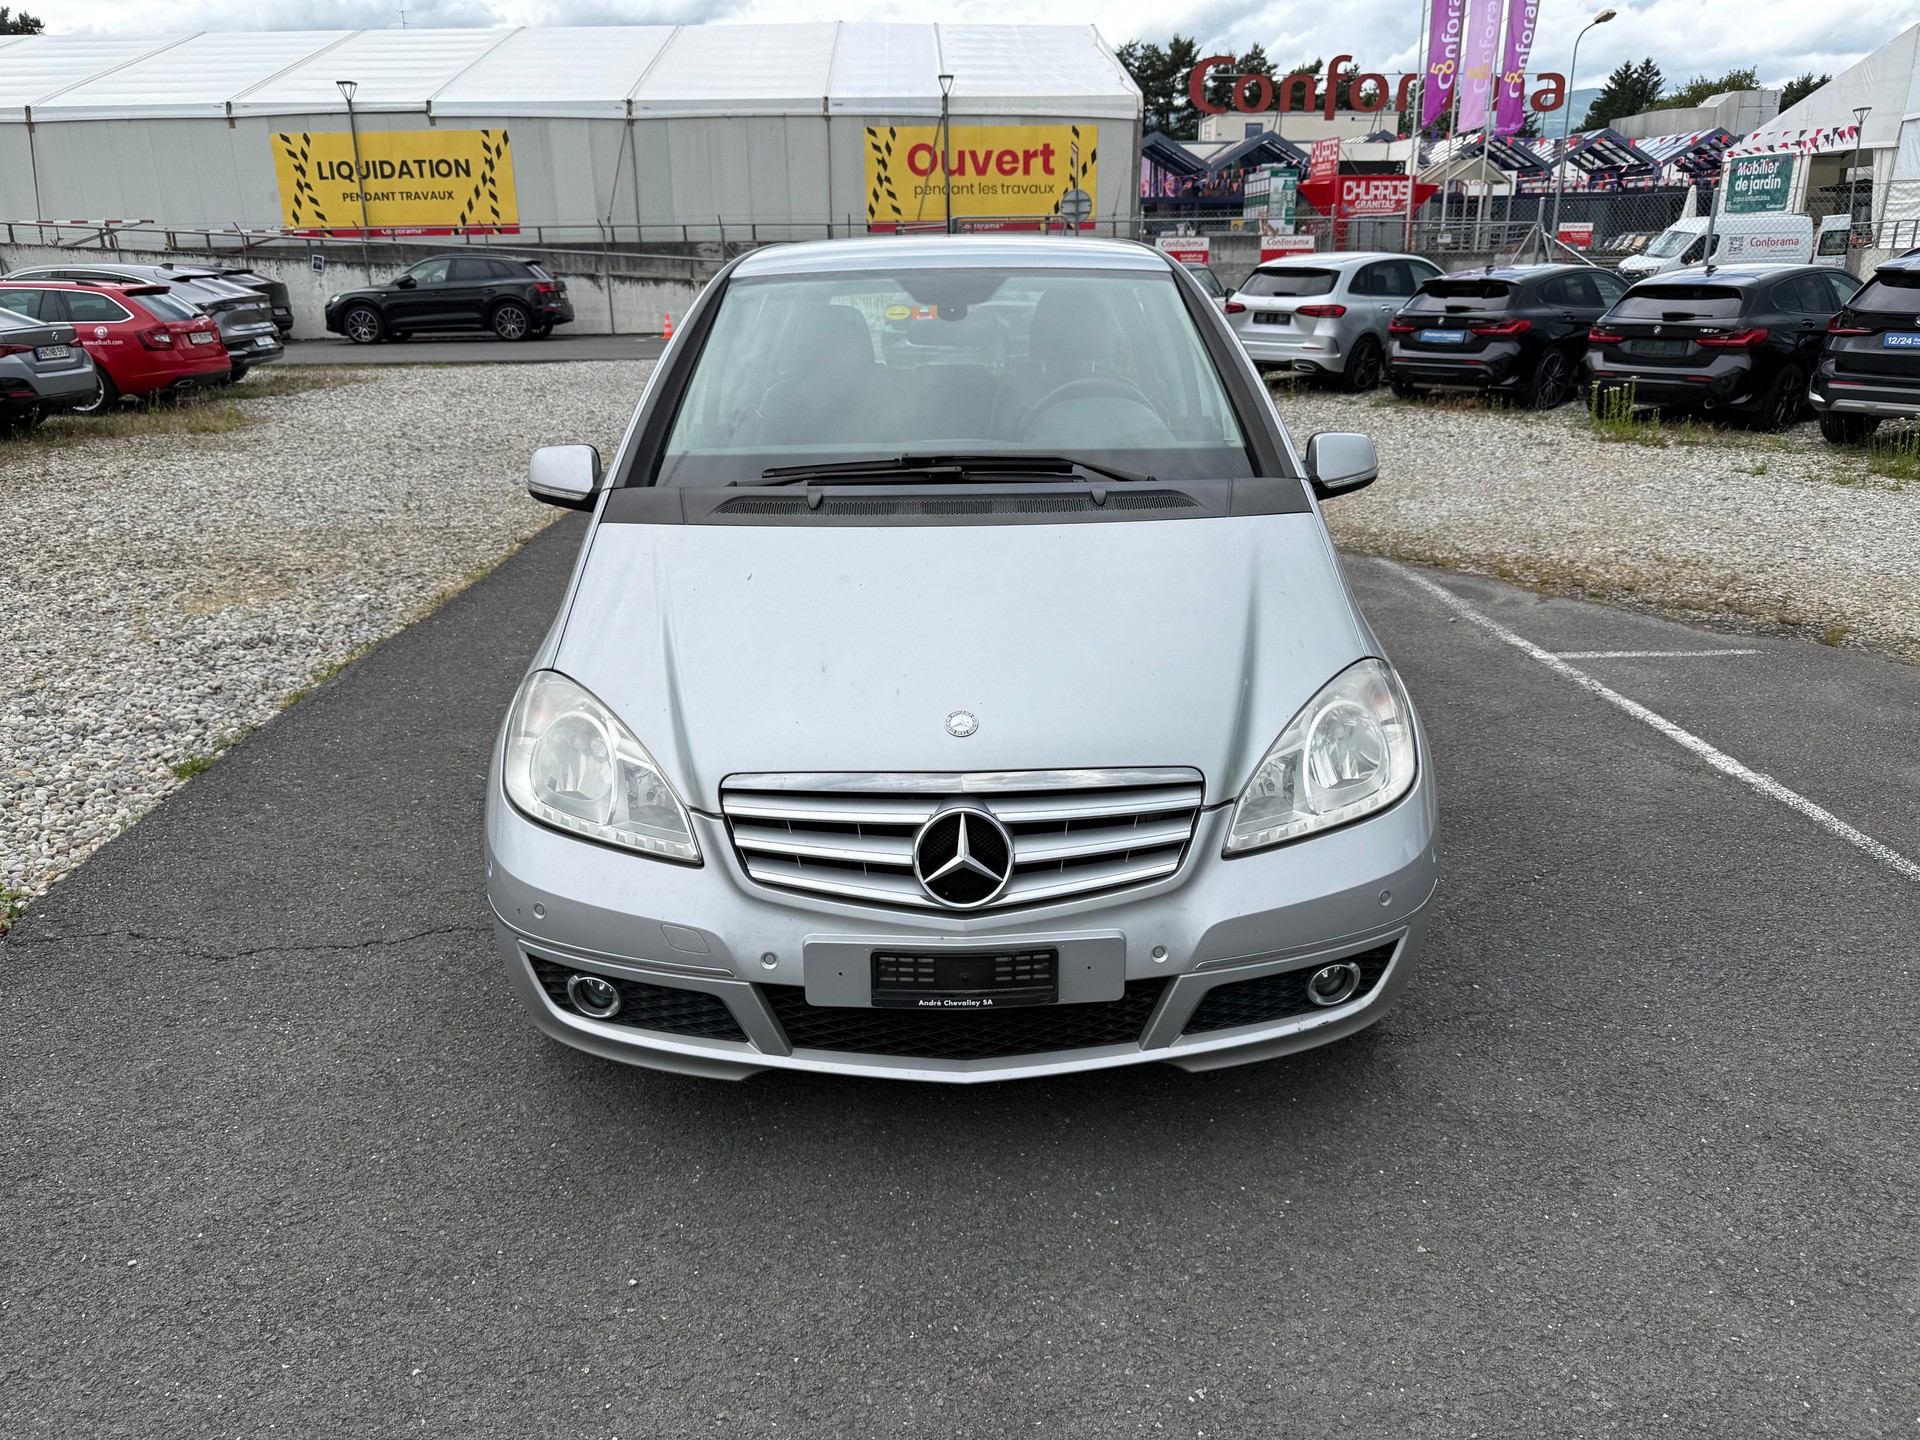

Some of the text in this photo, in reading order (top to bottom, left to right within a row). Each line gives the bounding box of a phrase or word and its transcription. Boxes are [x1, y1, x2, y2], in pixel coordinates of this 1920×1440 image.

[1189, 54, 1566, 121] Confora
[907, 143, 1055, 177] Ouvert
[316, 158, 472, 183] LIQUIDATION
[1737, 158, 1780, 176] Mobilier
[978, 182, 998, 195] les
[1001, 184, 1055, 195] travaux
[1343, 180, 1409, 201] CHURROS
[1735, 174, 1781, 195] de jardin
[342, 191, 454, 203] PENDANT TRAVAUX
[1354, 200, 1396, 209] GRANITAS
[1266, 238, 1310, 247] Conforama
[1750, 237, 1799, 248] Conforama
[1888, 336, 1912, 345] 12/24
[943, 999, 981, 1008] Chevalley
[982, 998, 993, 1006] SA
